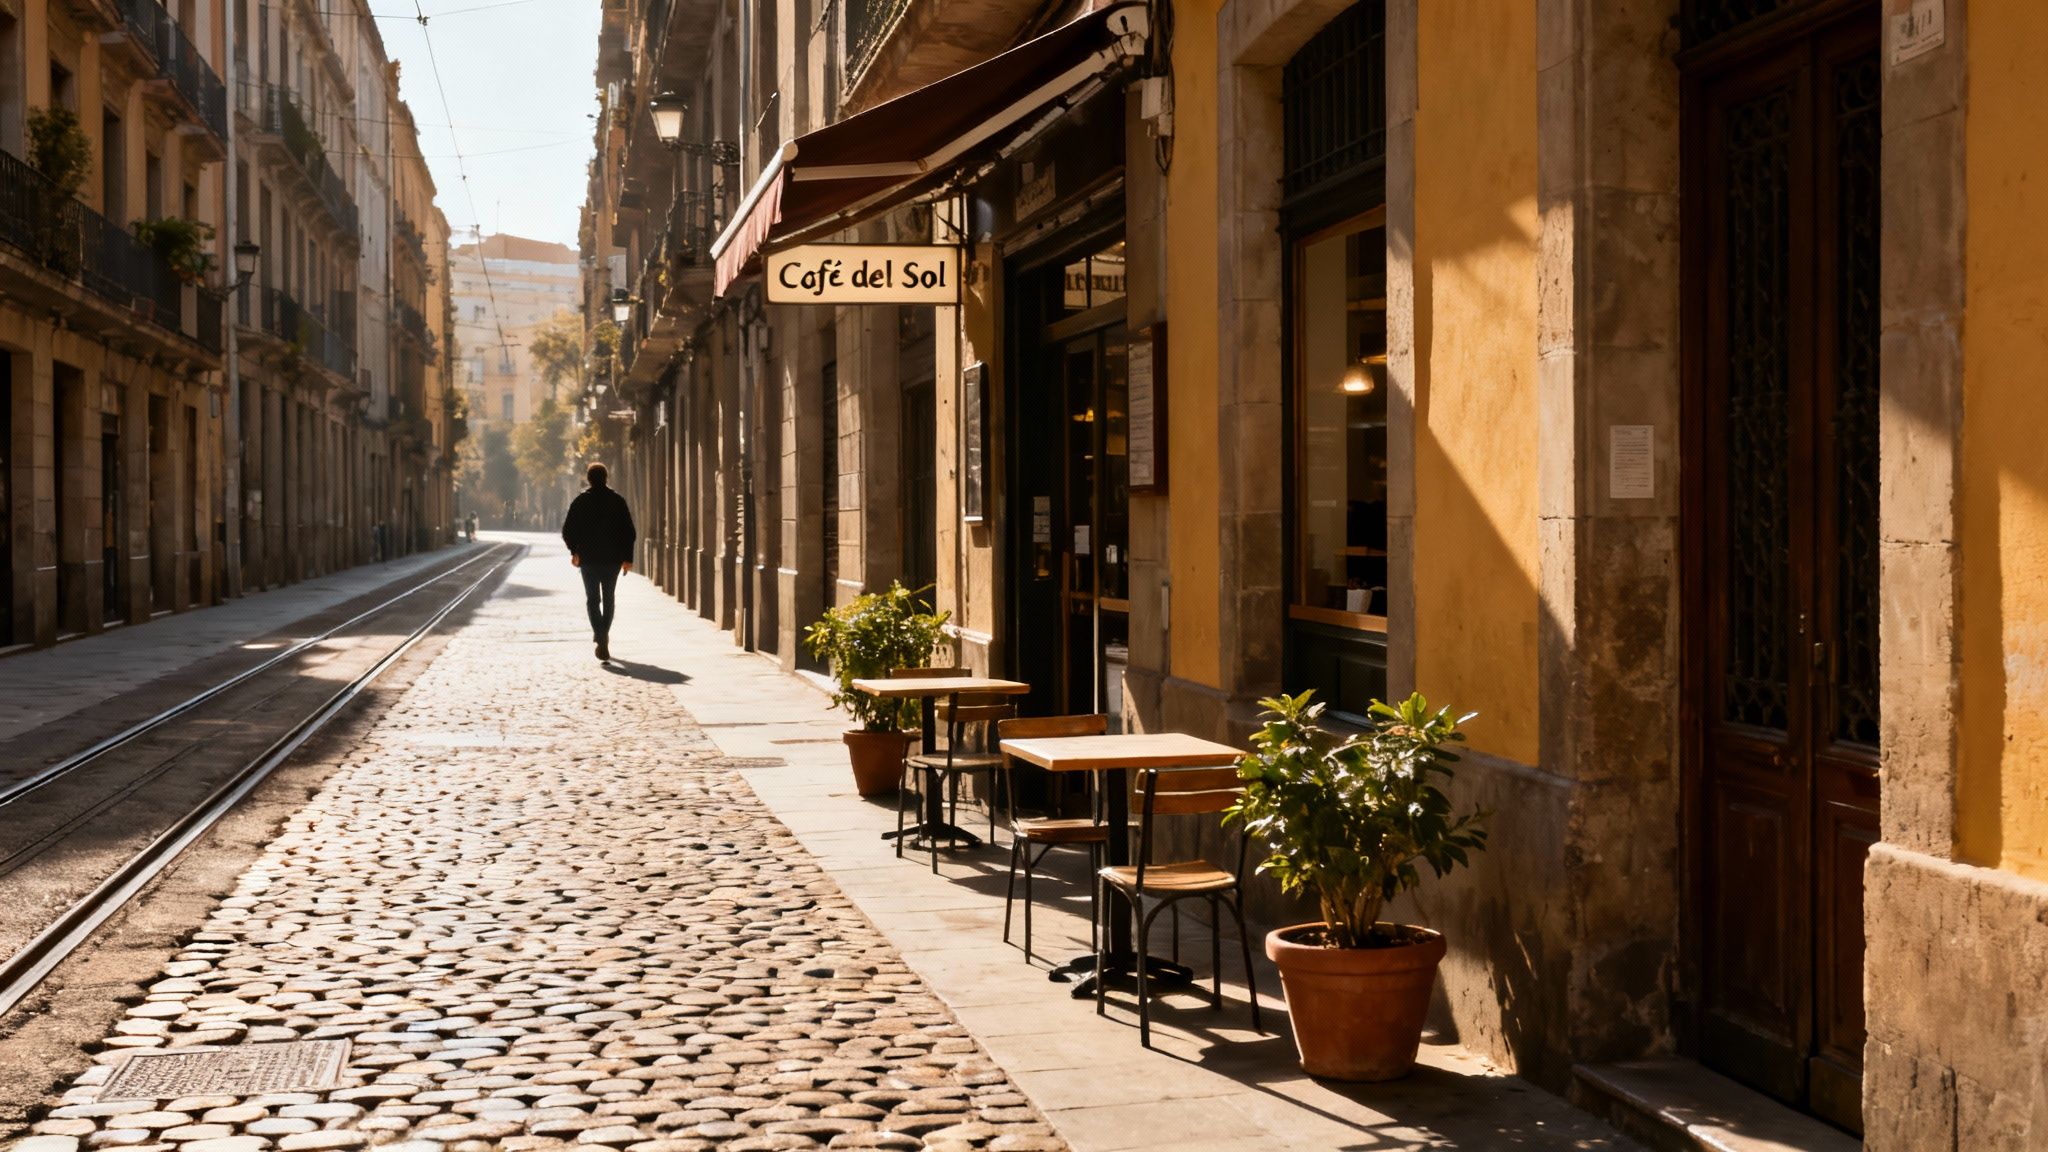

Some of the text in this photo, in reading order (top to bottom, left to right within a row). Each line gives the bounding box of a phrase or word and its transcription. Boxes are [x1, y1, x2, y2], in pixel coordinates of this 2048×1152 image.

[779, 259, 946, 296] Café del Sol
